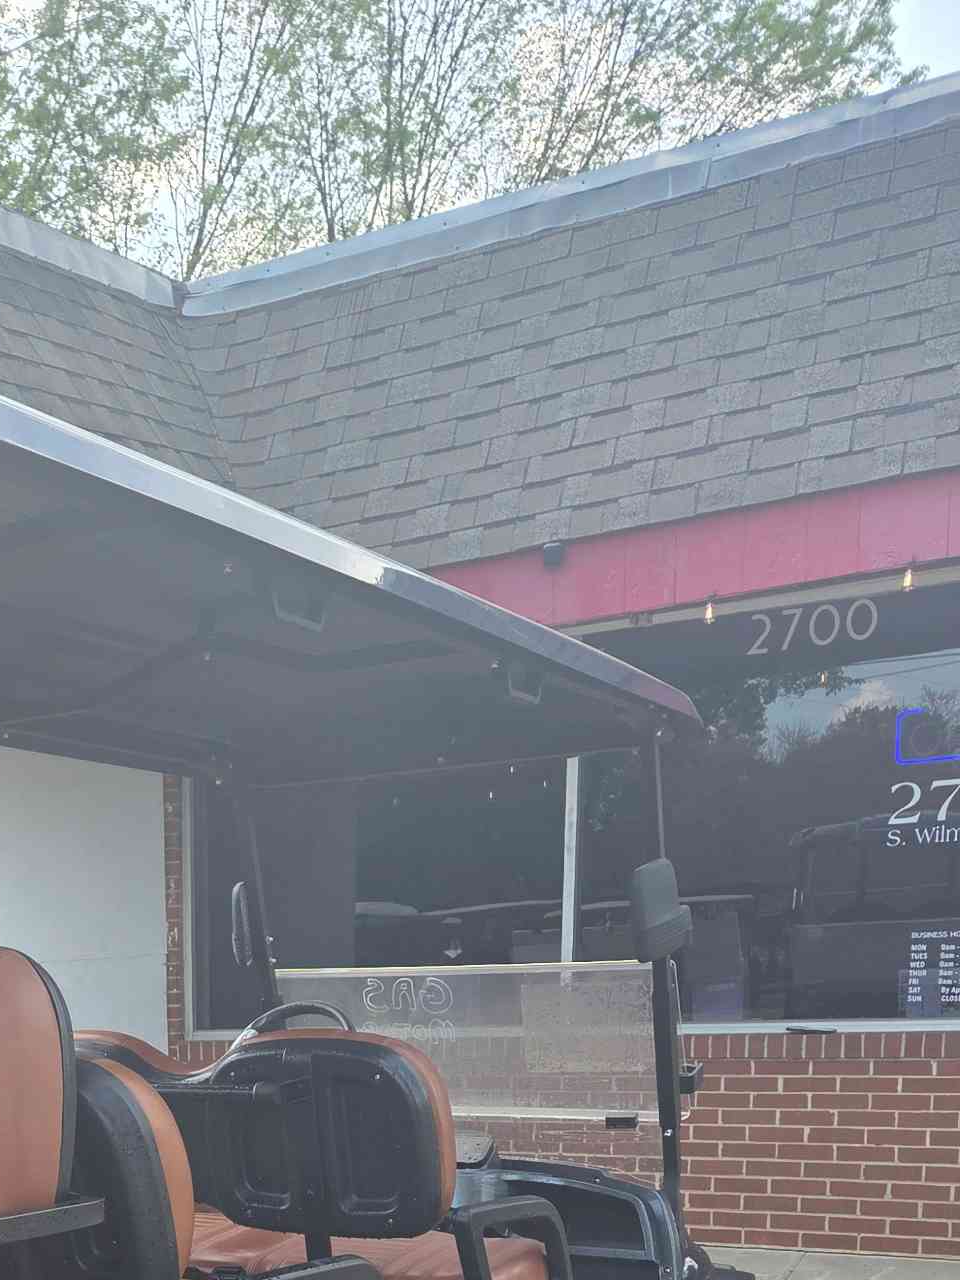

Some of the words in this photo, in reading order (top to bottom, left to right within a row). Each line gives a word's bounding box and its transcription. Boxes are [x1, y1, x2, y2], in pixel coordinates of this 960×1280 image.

[746, 599, 878, 655] 2700
[886, 829, 906, 847] S.
[912, 931, 948, 939] BUSINESS
[911, 943, 927, 951] MON
[911, 952, 928, 960] TUES
[908, 977, 919, 985] FRI
[940, 986, 950, 995] By
[906, 994, 922, 1002] SUN
